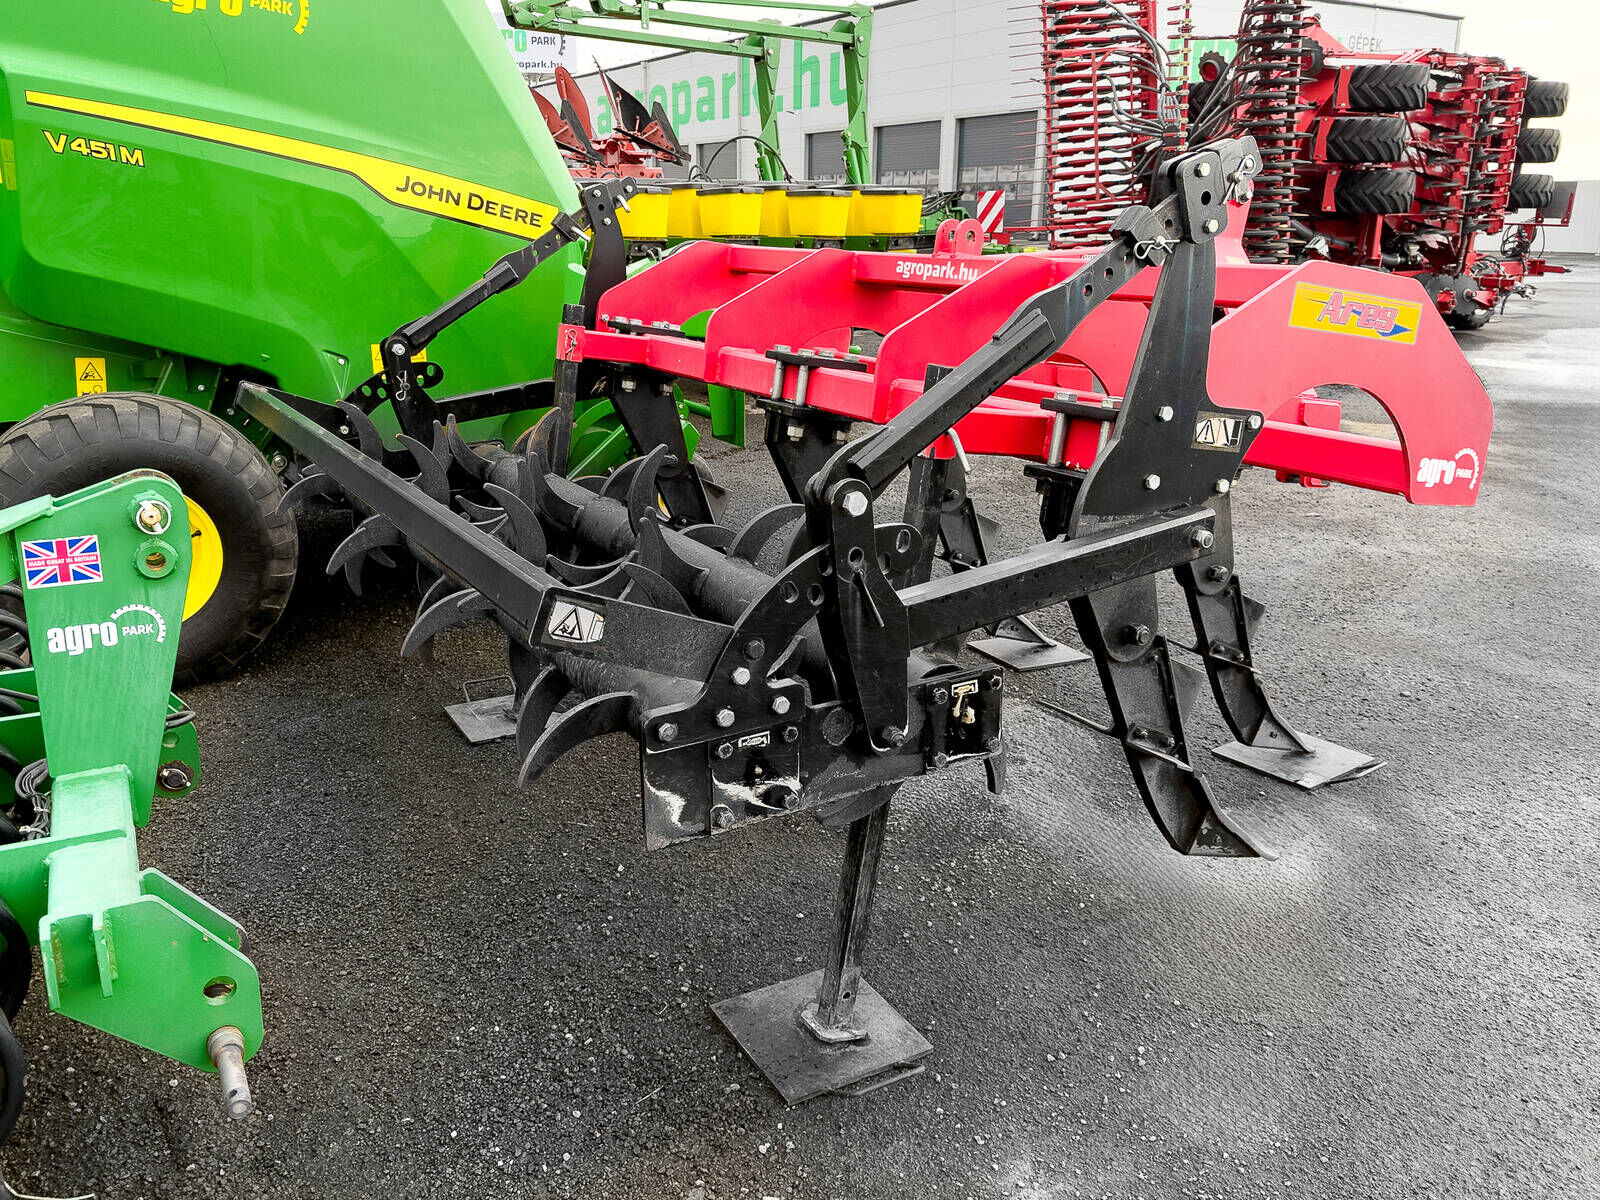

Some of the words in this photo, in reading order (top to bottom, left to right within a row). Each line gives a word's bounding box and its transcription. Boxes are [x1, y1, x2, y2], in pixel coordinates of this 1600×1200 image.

[531, 36, 556, 46] PARK
[1348, 32, 1384, 52] GÉPEK
[396, 176, 461, 206] JOHN
[467, 192, 543, 228] DEERE
[896, 260, 979, 281] agropark.hu
[1317, 291, 1399, 334] Ares
[1416, 457, 1456, 488] agro
[1455, 468, 1473, 479] PARK
[47, 621, 118, 656] agro
[122, 624, 155, 637] PARK
